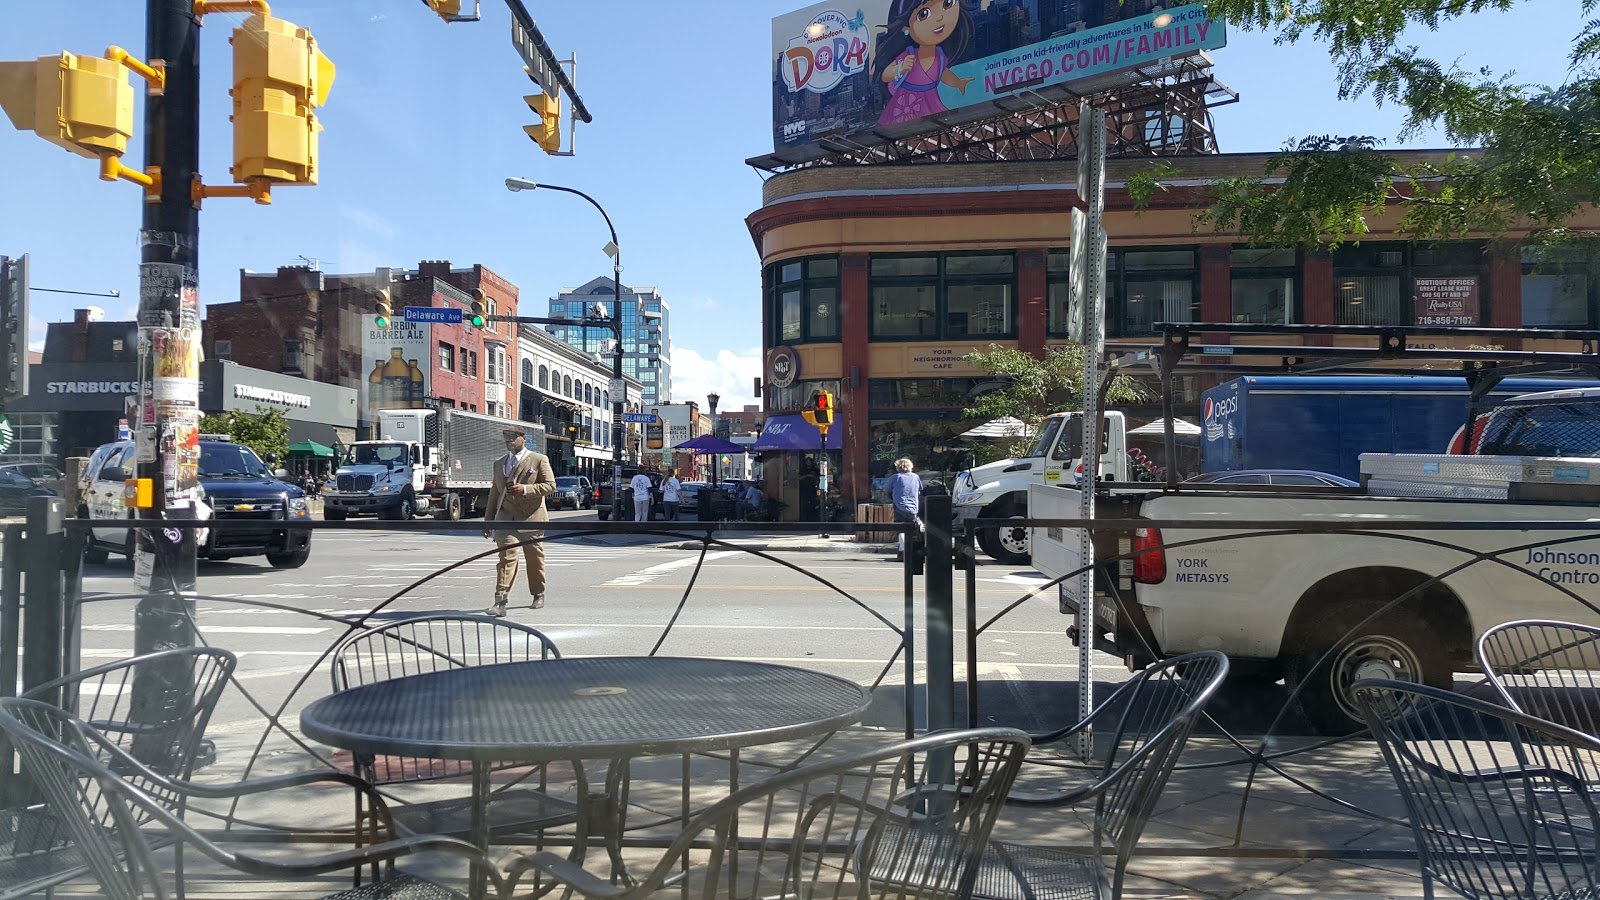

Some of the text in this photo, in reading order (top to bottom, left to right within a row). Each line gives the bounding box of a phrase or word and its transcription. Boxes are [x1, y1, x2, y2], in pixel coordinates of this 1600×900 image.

[835, 15, 847, 29] NYC
[984, 61, 1000, 71] Join
[1002, 56, 1020, 67] Dora
[1022, 52, 1032, 61] on
[1033, 38, 1081, 58] kid-friendly
[1082, 28, 1131, 46] adventures
[1133, 23, 1141, 33] in
[1143, 20, 1156, 31] Ne
[1170, 13, 1186, 24] ork
[785, 36, 867, 89] DORA
[984, 21, 1210, 93] NYCGO.COM/FAMILY
[784, 120, 805, 135] NYC
[406, 309, 460, 321] Delaware Ave
[369, 330, 424, 340] BARREL ALE
[46, 381, 139, 394] STARBUCKS
[1214, 390, 1239, 423] pepsi
[1176, 558, 1209, 568] YORK
[1525, 547, 1600, 565] Johnson
[1175, 573, 1230, 583] METASYS
